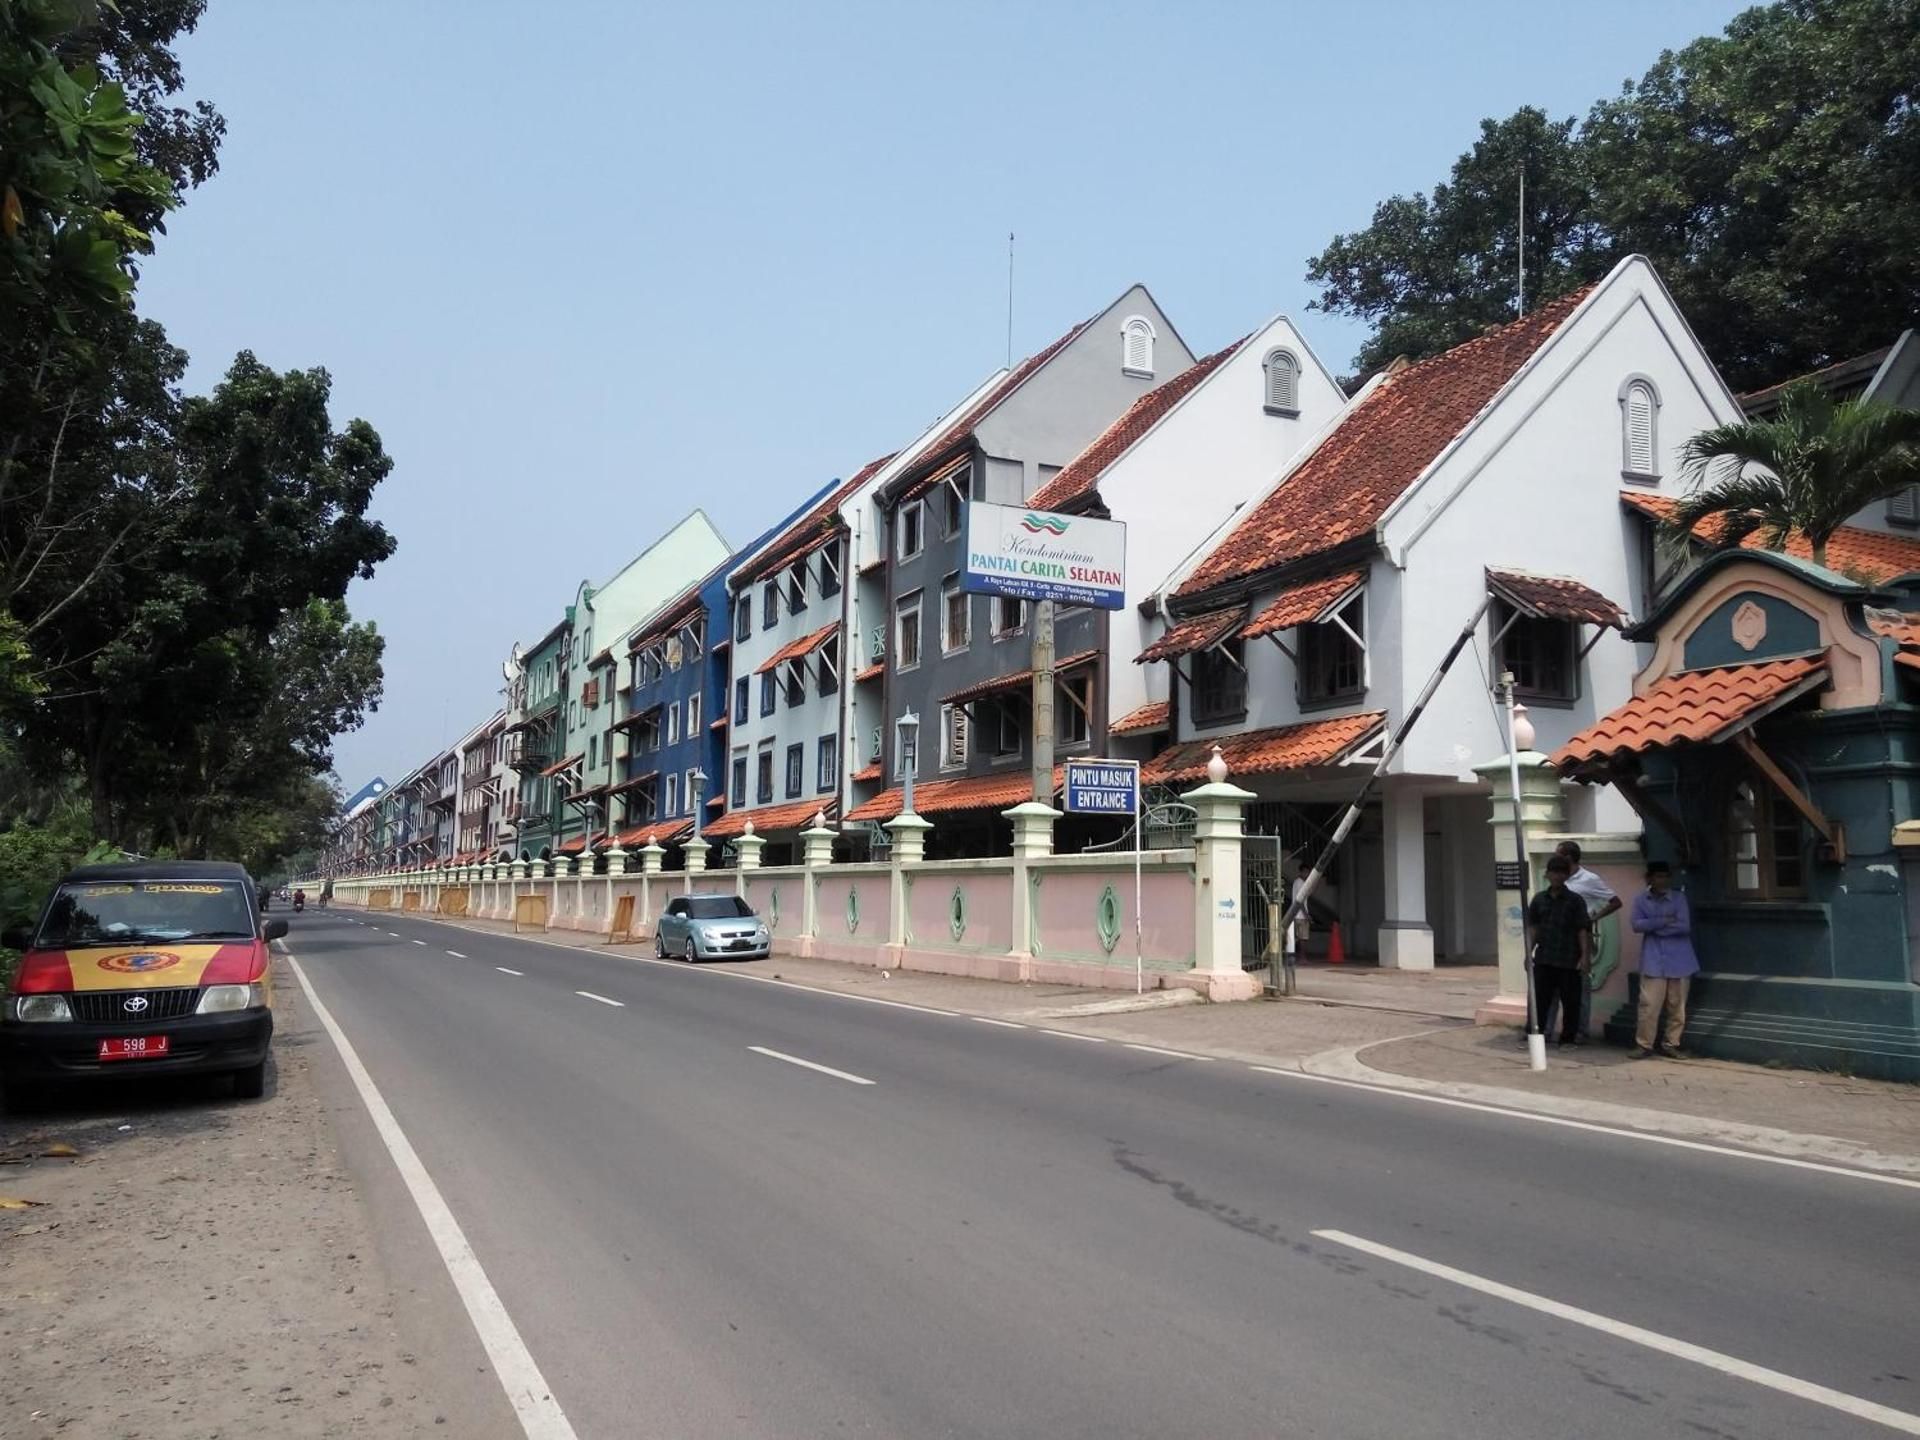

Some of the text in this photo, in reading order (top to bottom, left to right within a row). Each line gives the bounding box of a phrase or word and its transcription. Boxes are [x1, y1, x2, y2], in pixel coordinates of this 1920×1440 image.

[1002, 534, 1094, 563] Kondominium
[972, 553, 1121, 586] PANTAI CARITA SELATAN
[1072, 768, 1132, 787] PINTU MASUK
[1078, 791, 1127, 808] ENTRANCE
[102, 1035, 166, 1053] A 598 J
